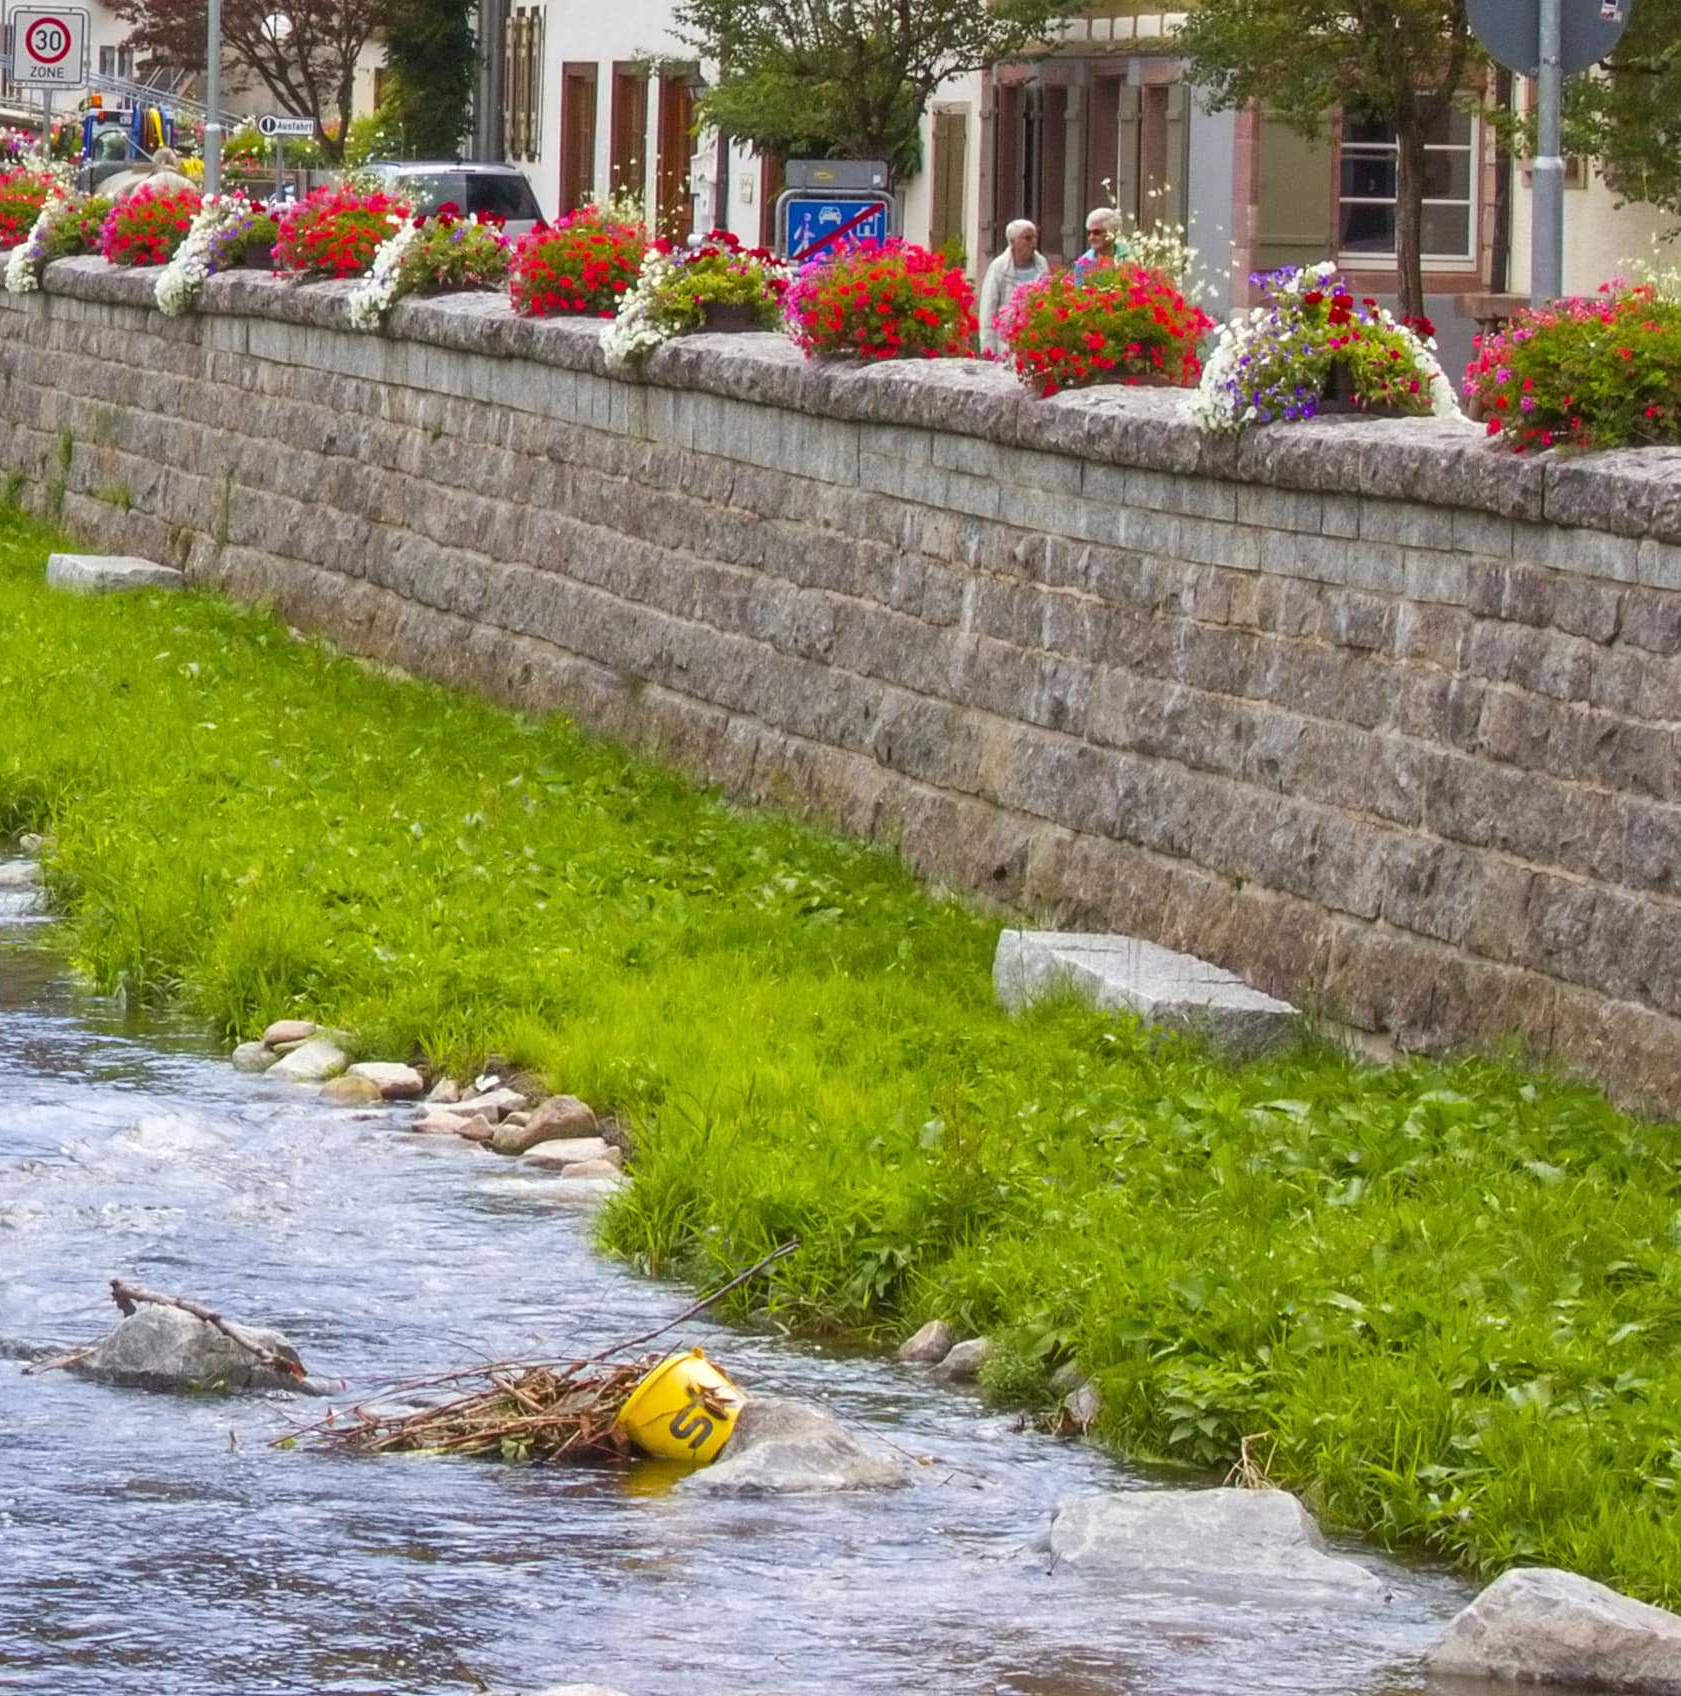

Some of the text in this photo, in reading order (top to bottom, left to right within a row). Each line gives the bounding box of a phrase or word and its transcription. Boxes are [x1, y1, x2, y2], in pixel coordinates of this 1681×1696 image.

[35, 30, 62, 52] 30
[29, 65, 65, 79] ZONE
[277, 120, 313, 131] Ausfahrt
